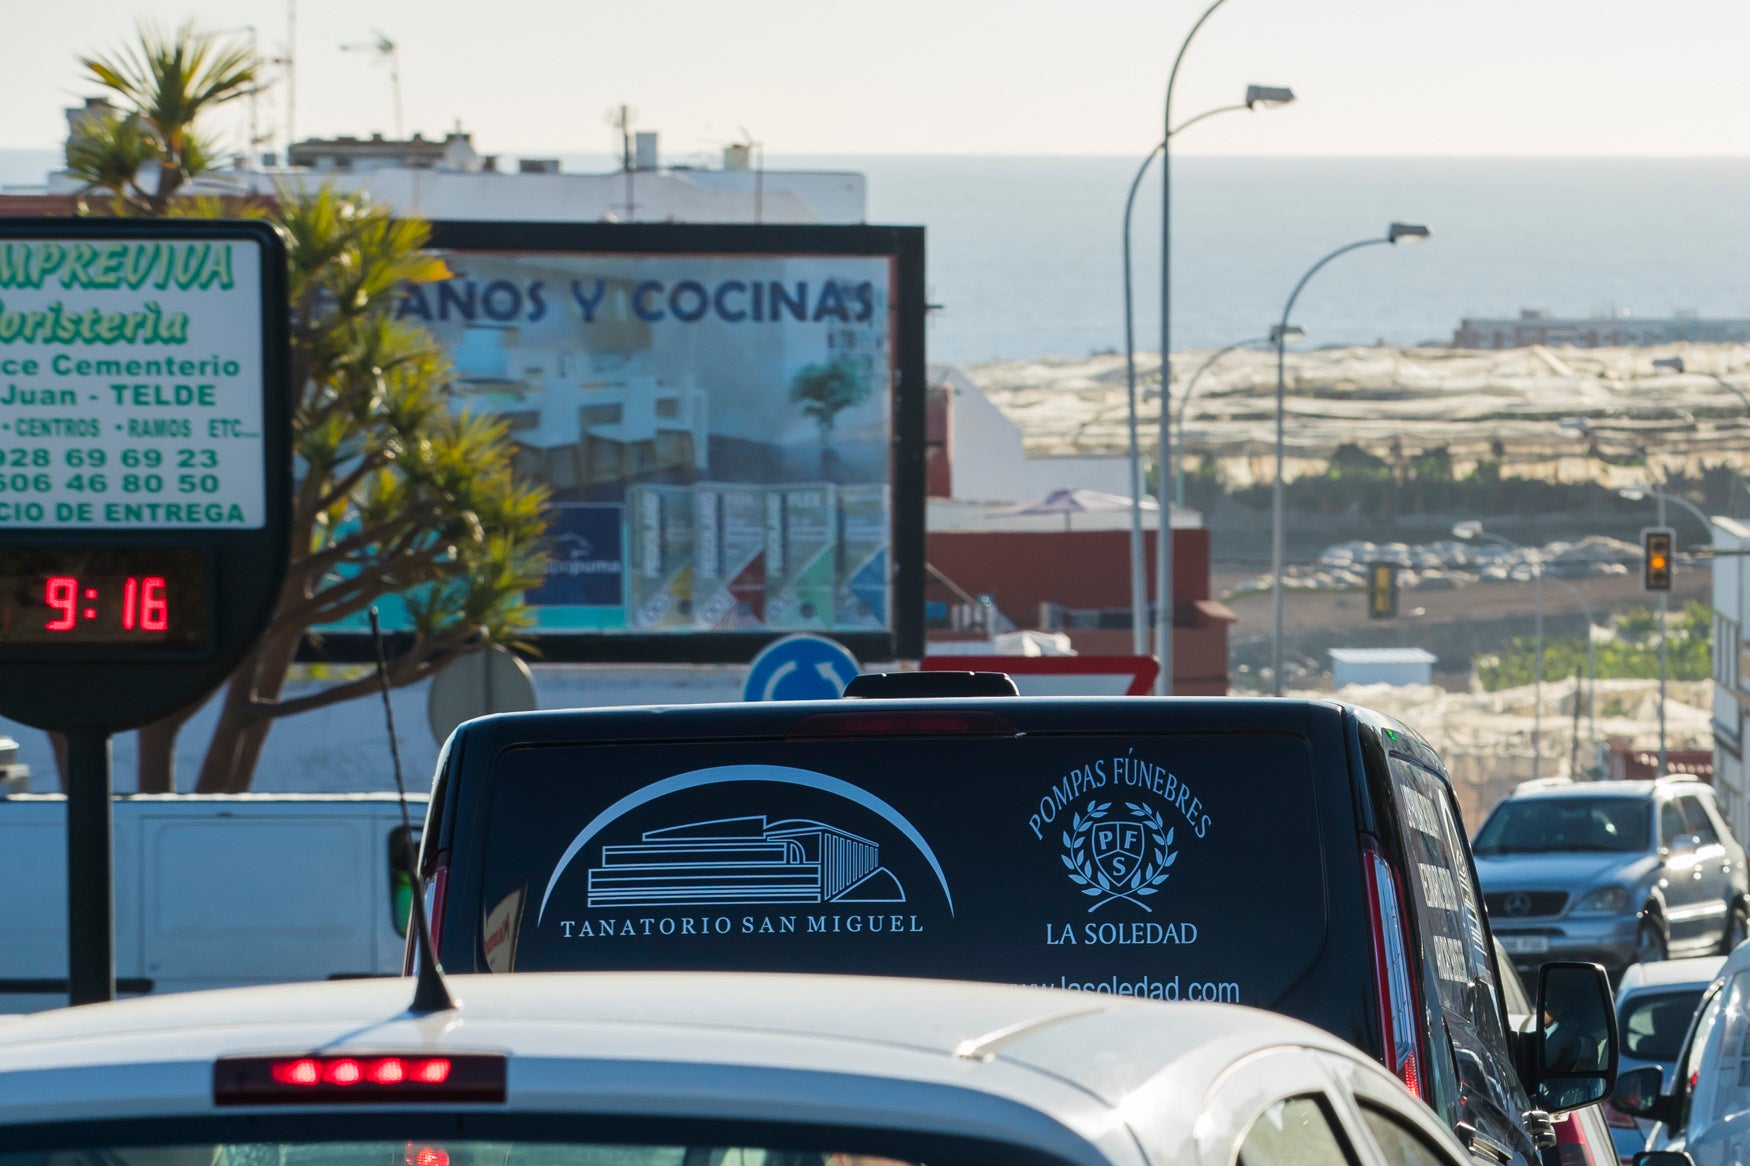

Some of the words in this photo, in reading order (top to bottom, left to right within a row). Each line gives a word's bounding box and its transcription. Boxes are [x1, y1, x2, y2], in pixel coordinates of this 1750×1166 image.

[573, 280, 607, 322] Y
[632, 279, 874, 322] COCINAS
[52, 354, 240, 377] Cementerio
[1, 385, 77, 406] Juan
[109, 384, 216, 406] TELDE
[15, 418, 100, 438] CENTROS
[128, 418, 192, 438] RAMOS
[65, 448, 107, 468] 69
[121, 448, 163, 468] 69
[178, 448, 219, 468] 23
[65, 474, 108, 493] 46
[123, 474, 163, 493] 80
[178, 474, 219, 493] 50
[56, 503, 93, 522] DE
[104, 503, 245, 522] ENTREGA
[45, 576, 168, 631] 9:16
[1029, 759, 1107, 841] POMPAS
[1113, 747, 1212, 839] FÚNEBRES
[560, 916, 732, 939] TANATORIO
[741, 915, 796, 933] SAN
[806, 914, 924, 933] MIGUEL
[1046, 922, 1077, 945] LA
[1085, 922, 1198, 945] SOLEDAD
